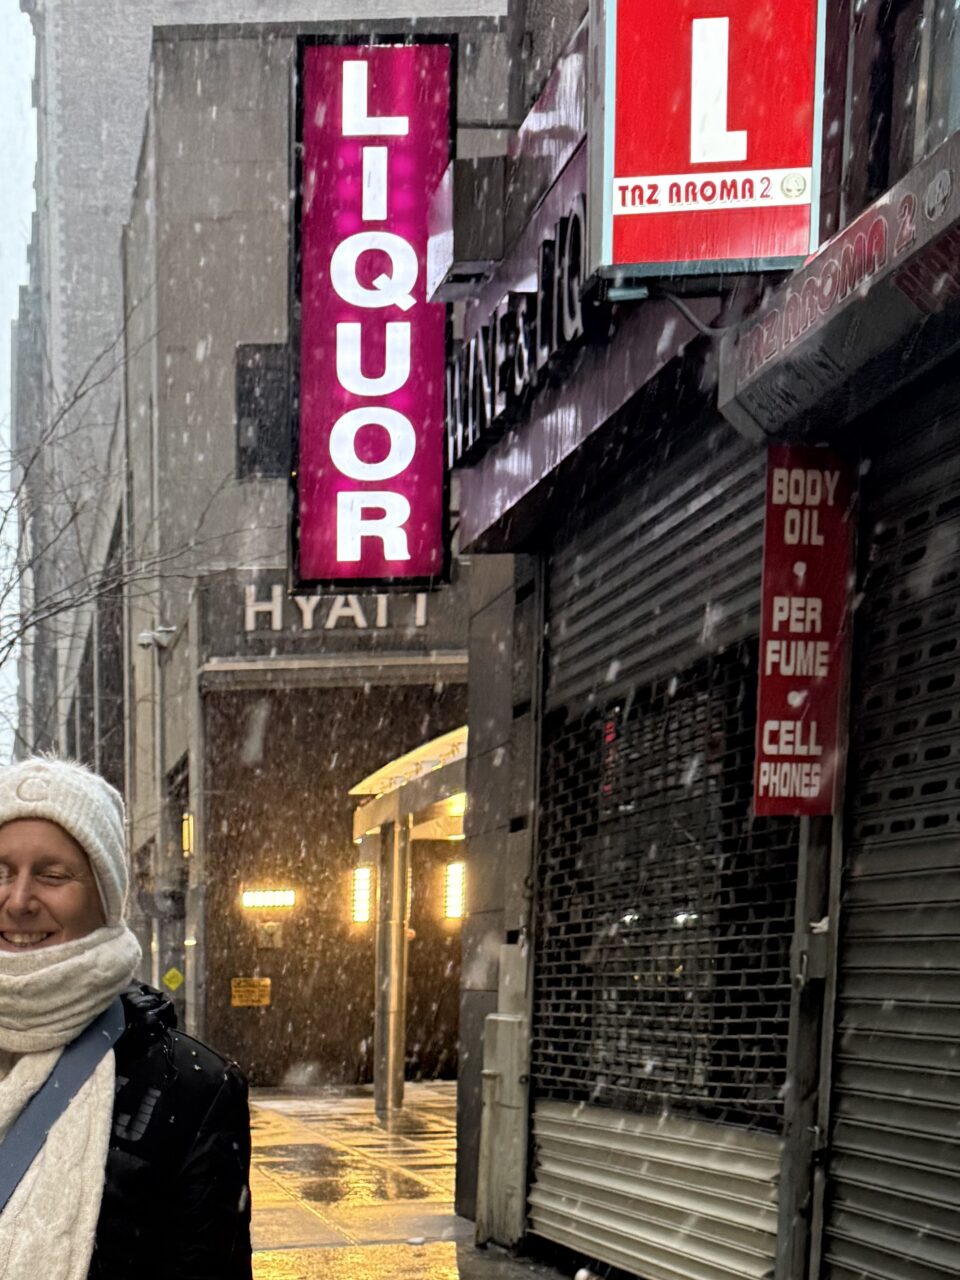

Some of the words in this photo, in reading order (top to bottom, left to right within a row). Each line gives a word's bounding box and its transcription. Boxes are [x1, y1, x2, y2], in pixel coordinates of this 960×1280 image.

[690, 16, 748, 164] L
[618, 184, 660, 208] TAZ
[669, 178, 755, 204] AROMA
[760, 176, 772, 199] 2
[783, 215, 888, 348] AROMA
[895, 193, 918, 257] 2
[329, 60, 420, 562] LIQUOR
[772, 468, 840, 506] BODY
[784, 508, 825, 546] OIL
[245, 585, 427, 631] HYATT
[773, 596, 822, 633] PER
[765, 640, 830, 677] FUME
[763, 720, 823, 756] CELL
[759, 762, 822, 798] PHONES
